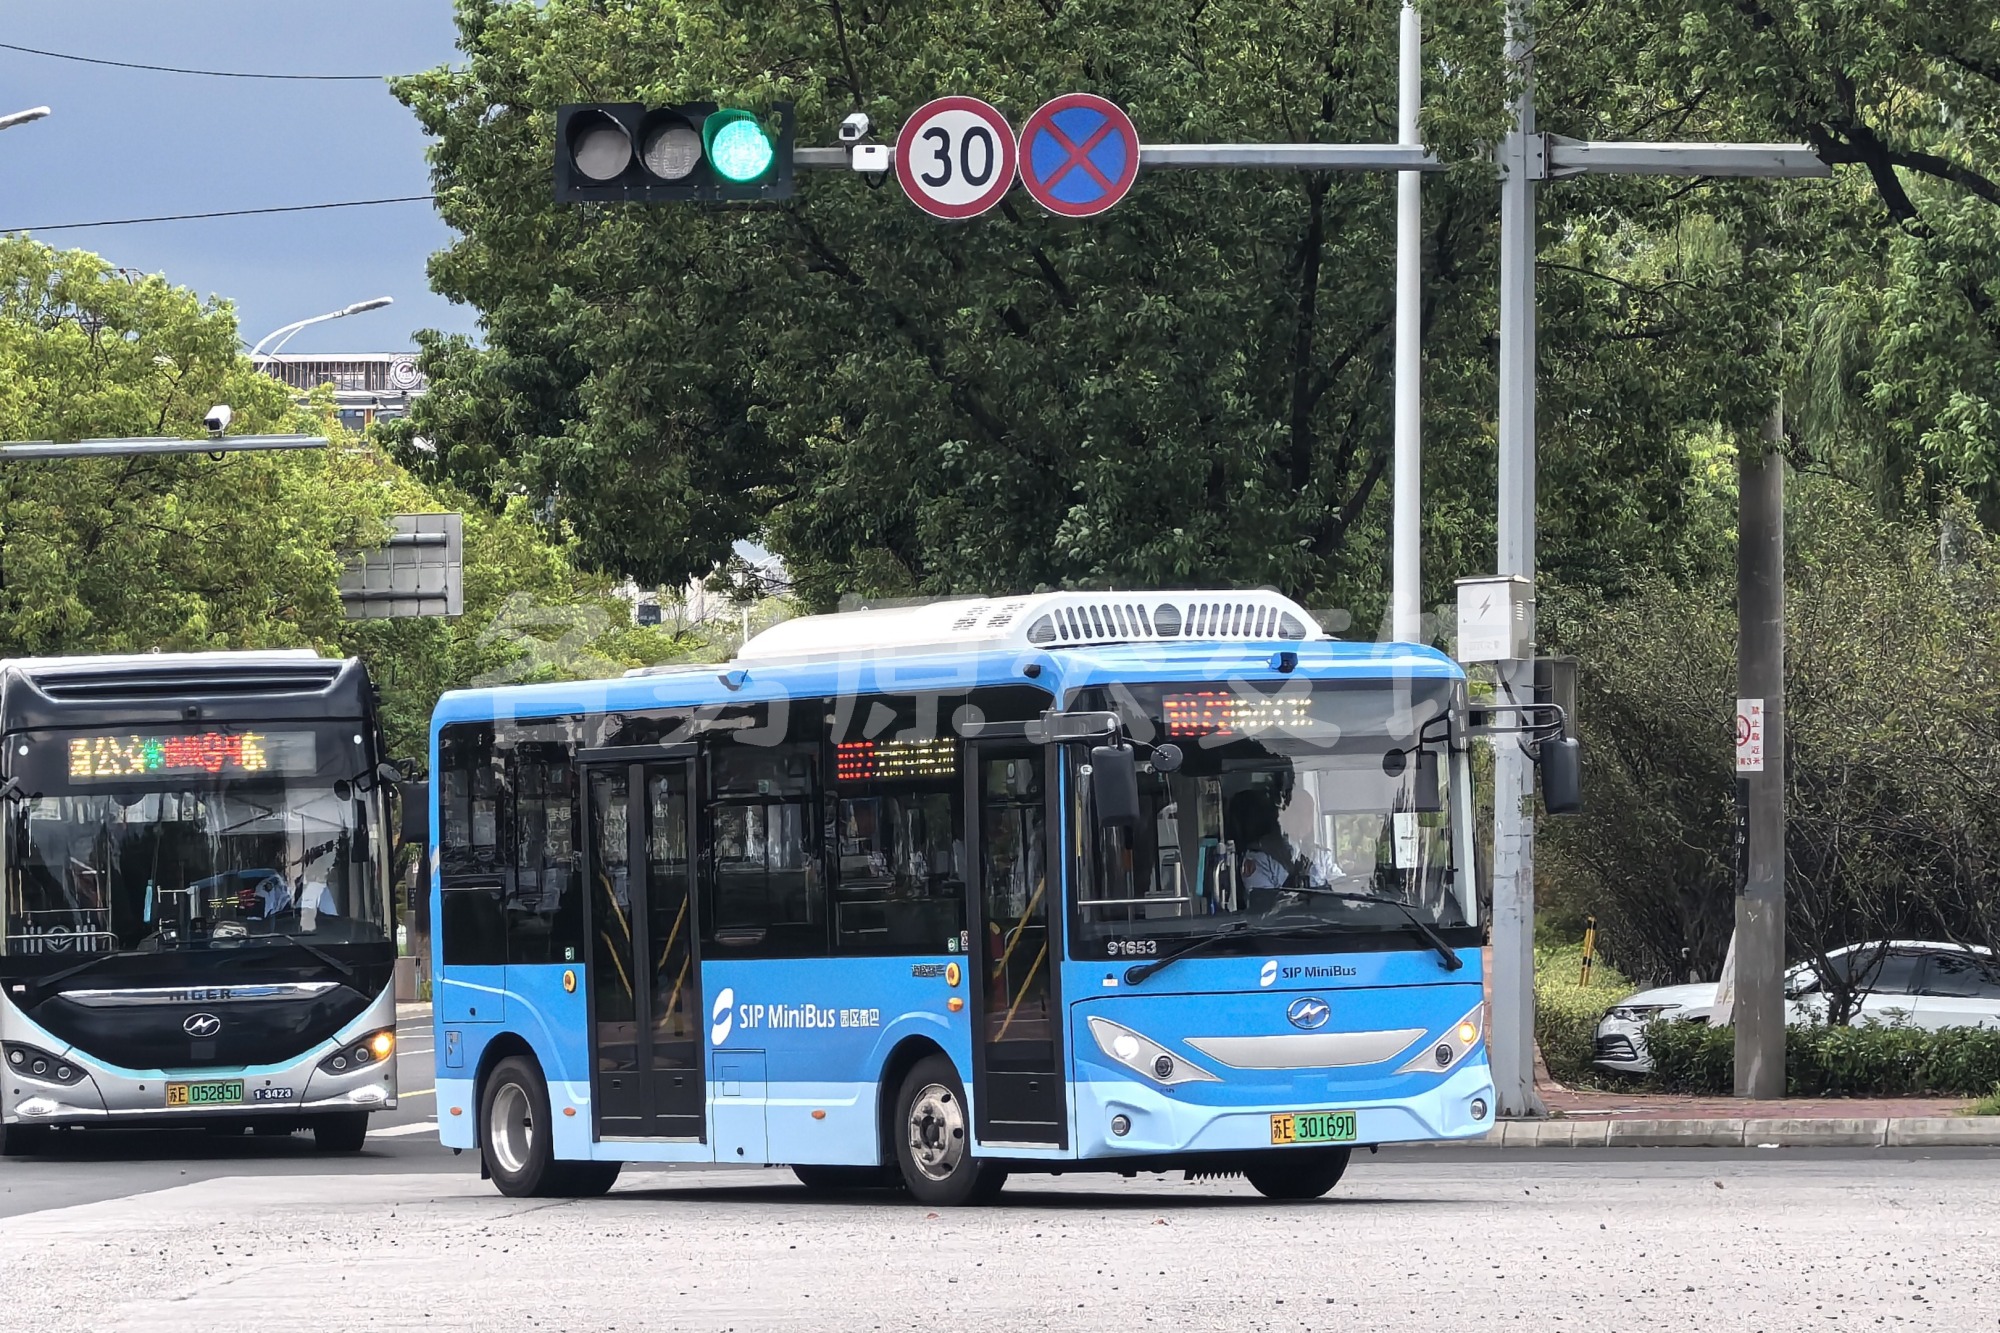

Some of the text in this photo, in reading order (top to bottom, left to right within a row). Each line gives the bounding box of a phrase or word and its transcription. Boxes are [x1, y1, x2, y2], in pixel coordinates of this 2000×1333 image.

[921, 127, 994, 187] 30
[1107, 940, 1157, 955] 91653
[1282, 965, 1357, 979] SIP MiniBus
[739, 1004, 835, 1028] SIP MiniBus
